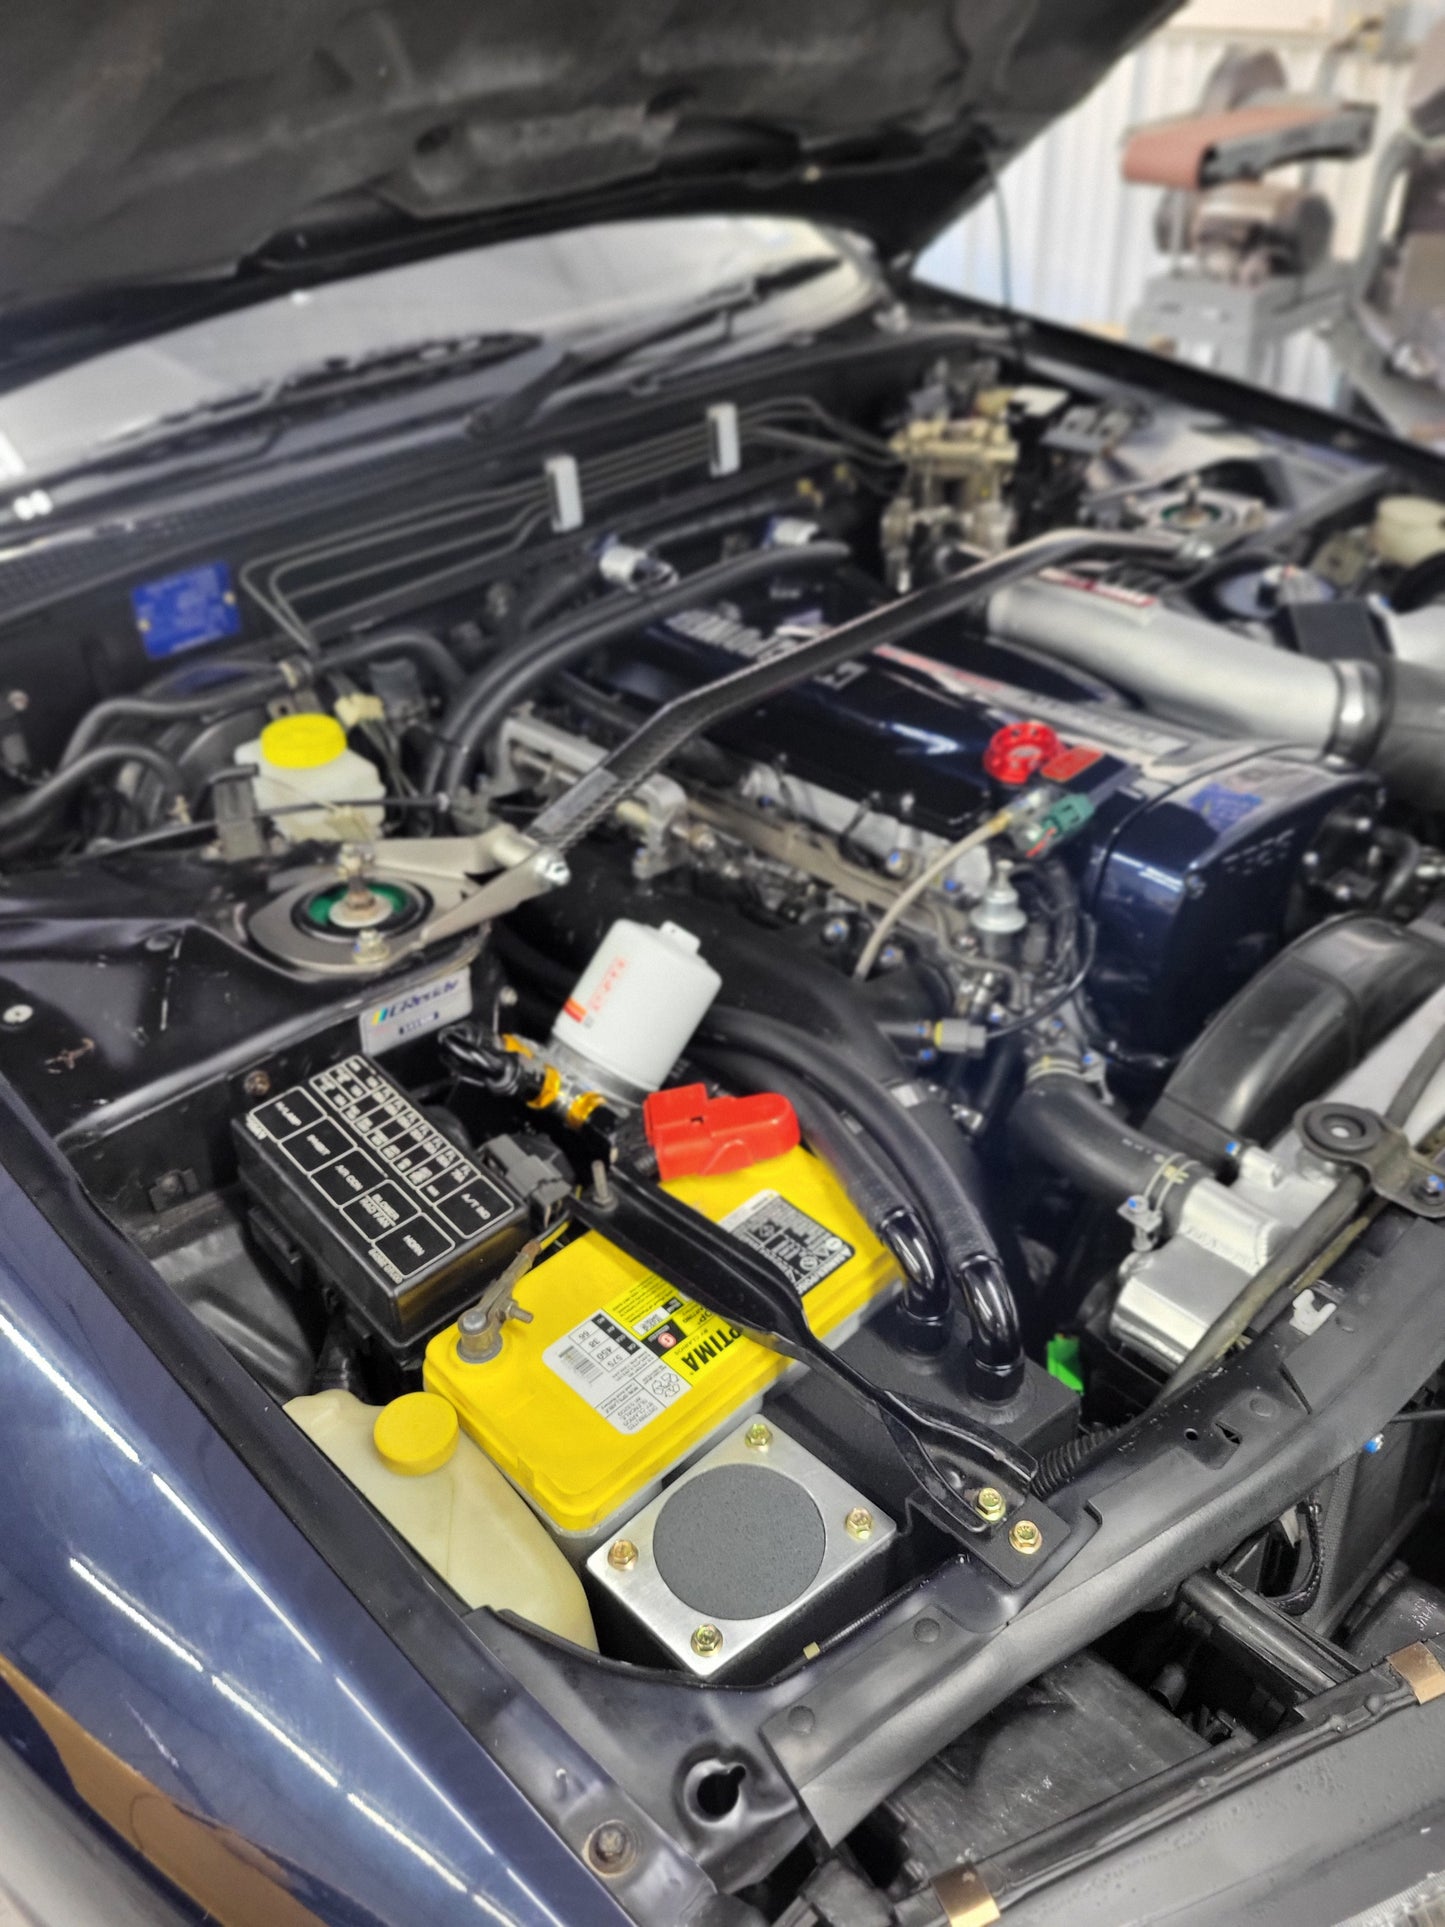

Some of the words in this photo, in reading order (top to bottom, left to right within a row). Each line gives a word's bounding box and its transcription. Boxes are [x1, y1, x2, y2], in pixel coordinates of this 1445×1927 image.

[333, 1162, 351, 1178] AIR
[343, 1173, 364, 1192] CON
[358, 1197, 377, 1214] RAD
[371, 1211, 390, 1228] FAN
[370, 1192, 400, 1221] BLOWER
[401, 1234, 426, 1256] HORN
[595, 1345, 613, 1360] 450
[605, 1353, 623, 1368] 575
[681, 1328, 742, 1372] PTIMA
